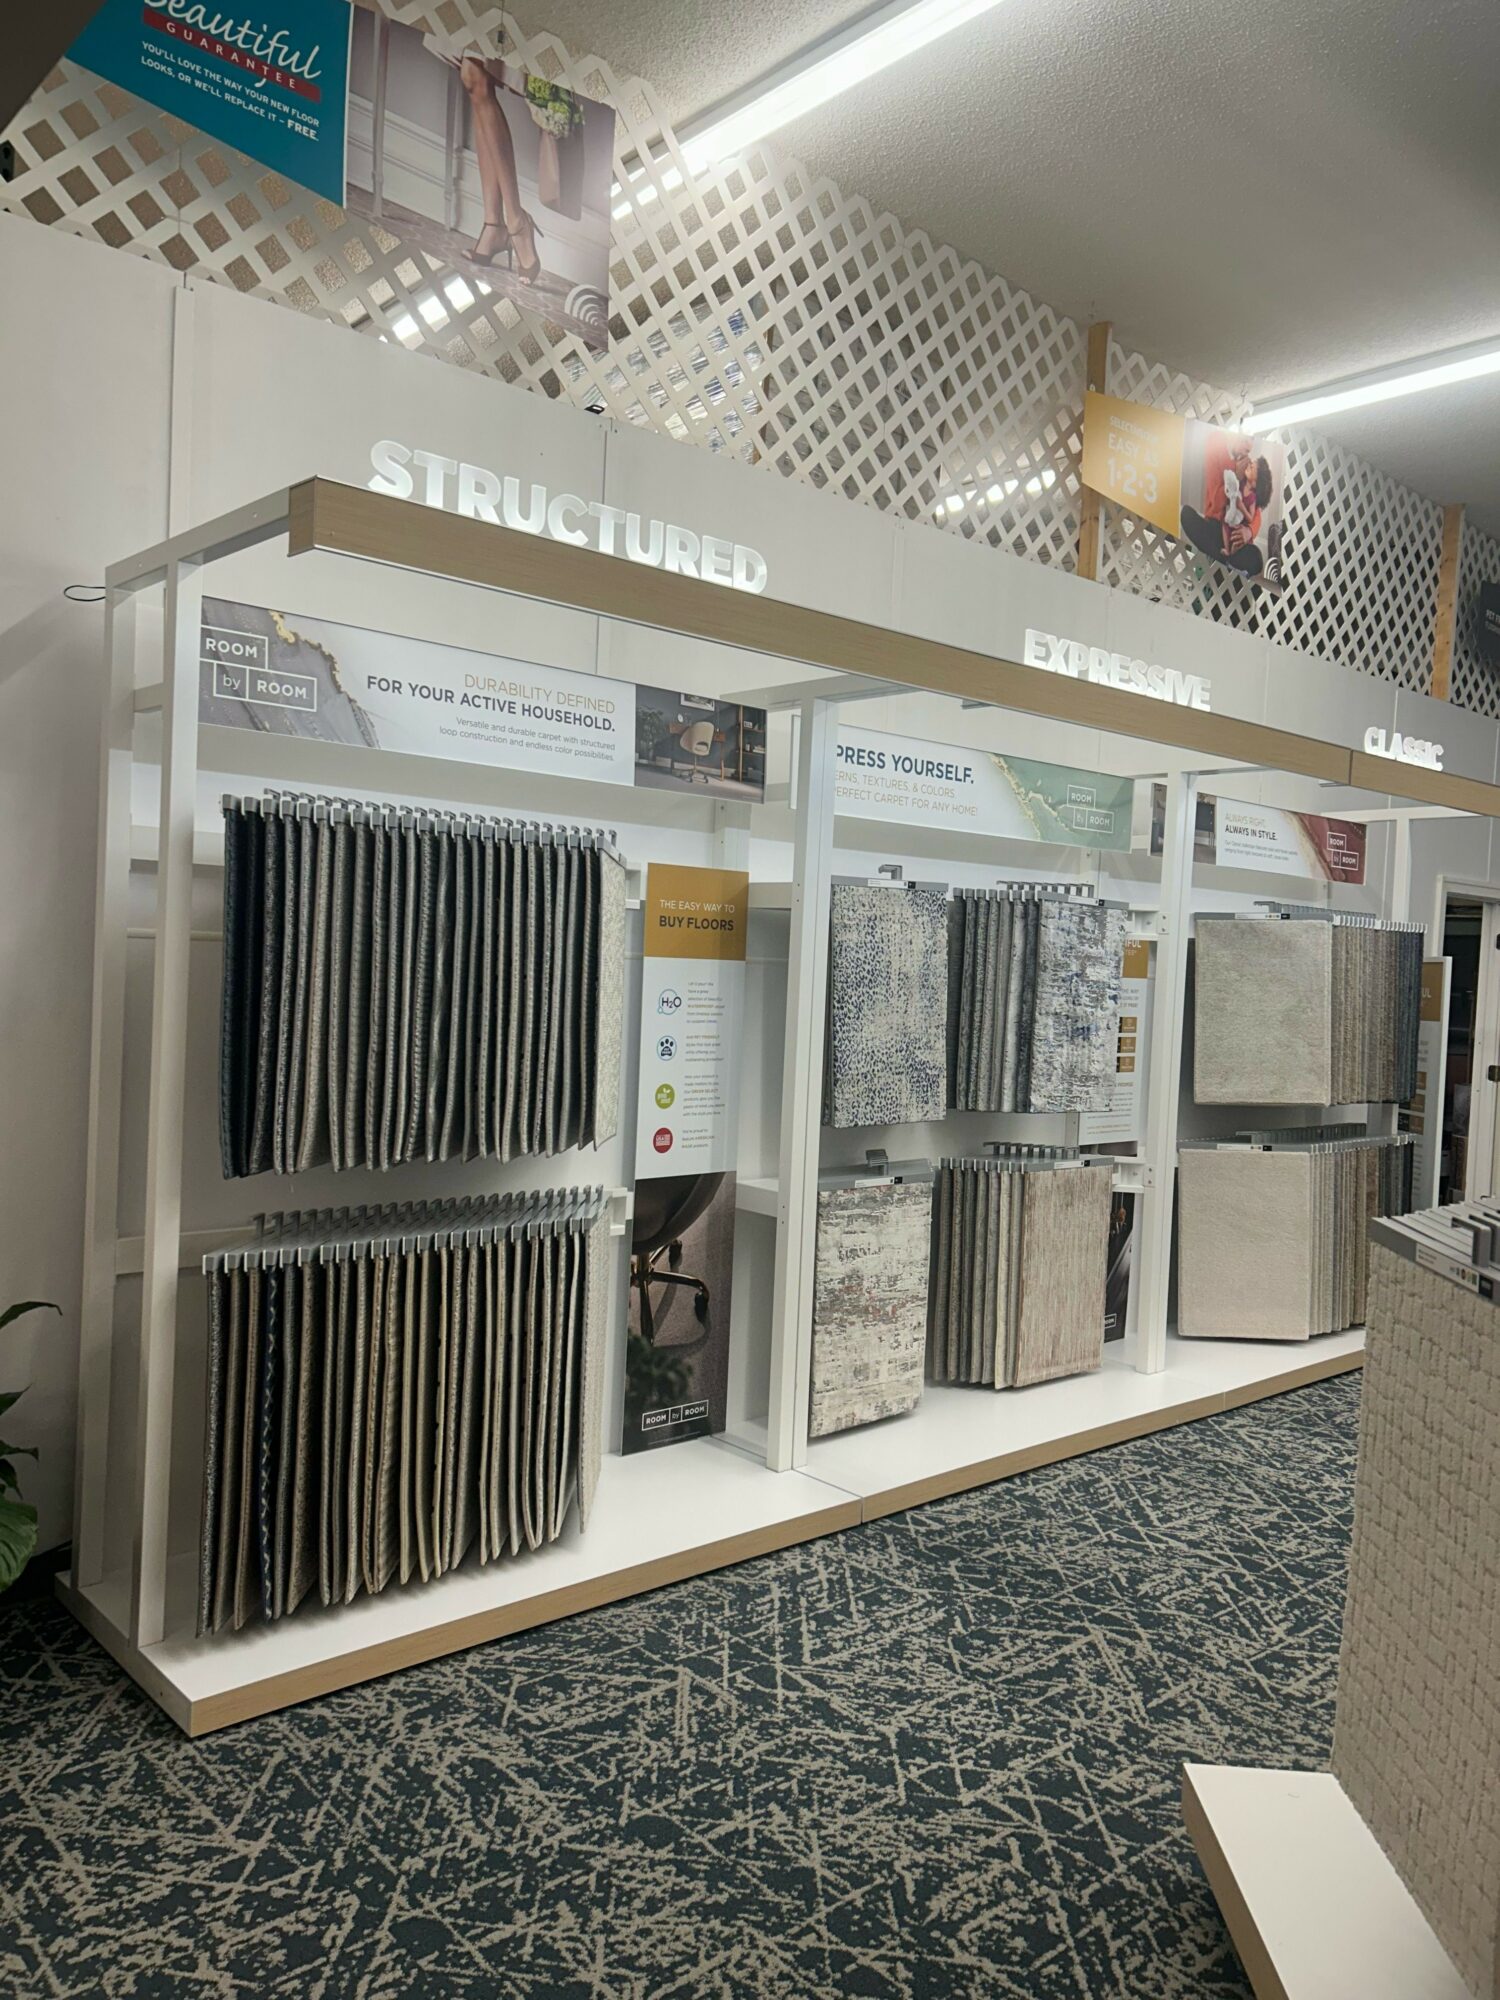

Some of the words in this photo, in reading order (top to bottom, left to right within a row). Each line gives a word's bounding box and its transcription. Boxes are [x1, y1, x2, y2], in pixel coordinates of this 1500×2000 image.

[166, 22, 296, 89] GUARANTEE
[142, 41, 176, 63] YOU'LL
[177, 57, 202, 74] LOVE
[203, 68, 222, 83] THE
[223, 77, 243, 92] WAY
[244, 87, 269, 104] YOUR
[270, 99, 290, 114] NEW
[291, 108, 320, 127] FLOOR
[141, 55, 175, 78] LOOKS,
[177, 72, 192, 84] OR
[194, 79, 222, 98] WE'LL
[224, 92, 266, 118] REPLACE
[267, 112, 277, 122] IT
[287, 119, 320, 142] FREE.
[1108, 432, 1140, 458] EASY
[367, 439, 768, 594] STRUCTURED
[205, 637, 258, 659] ROOM
[1023, 628, 1212, 713] EXPRESSIVE
[223, 674, 241, 690] by
[257, 679, 307, 700] ROOM
[464, 674, 553, 702] DURABILITY
[556, 691, 615, 714] DEFINED
[367, 675, 403, 695] FOR
[408, 682, 455, 704] YOUR
[460, 692, 517, 715] ACTIVE
[521, 703, 615, 732] HOUSEHOLD.
[439, 725, 458, 737] loop
[459, 730, 508, 744] construction
[509, 738, 524, 747] and
[525, 740, 553, 752] endless
[554, 746, 573, 754] color
[456, 716, 489, 730] Versatile
[491, 724, 506, 733] and
[508, 726, 536, 738] durable
[538, 731, 561, 743] carpet
[563, 735, 579, 744] with
[580, 739, 616, 751] structured
[1364, 726, 1444, 772] CLASSIC
[891, 754, 975, 784] YOURSELF.
[834, 786, 872, 801] ERFECT
[873, 792, 909, 807] CARPET
[911, 798, 930, 810] FOR
[930, 801, 950, 812] ANY
[912, 782, 919, 793] &
[920, 783, 955, 798] COLORS
[1071, 792, 1092, 804] ROOM
[1089, 815, 1110, 827] ROOM
[1225, 824, 1249, 836] ALWAYS
[1250, 828, 1257, 837] IN
[1329, 837, 1344, 847] ROOM
[1342, 856, 1356, 865] ROOM
[660, 899, 676, 910] THE
[678, 900, 701, 911] EASY
[703, 903, 722, 913] WAY
[723, 904, 735, 914] TO
[659, 915, 685, 928] BUY
[687, 917, 735, 932] FLOORS
[646, 1414, 667, 1425] ROOM
[684, 1406, 705, 1416] ROOM
